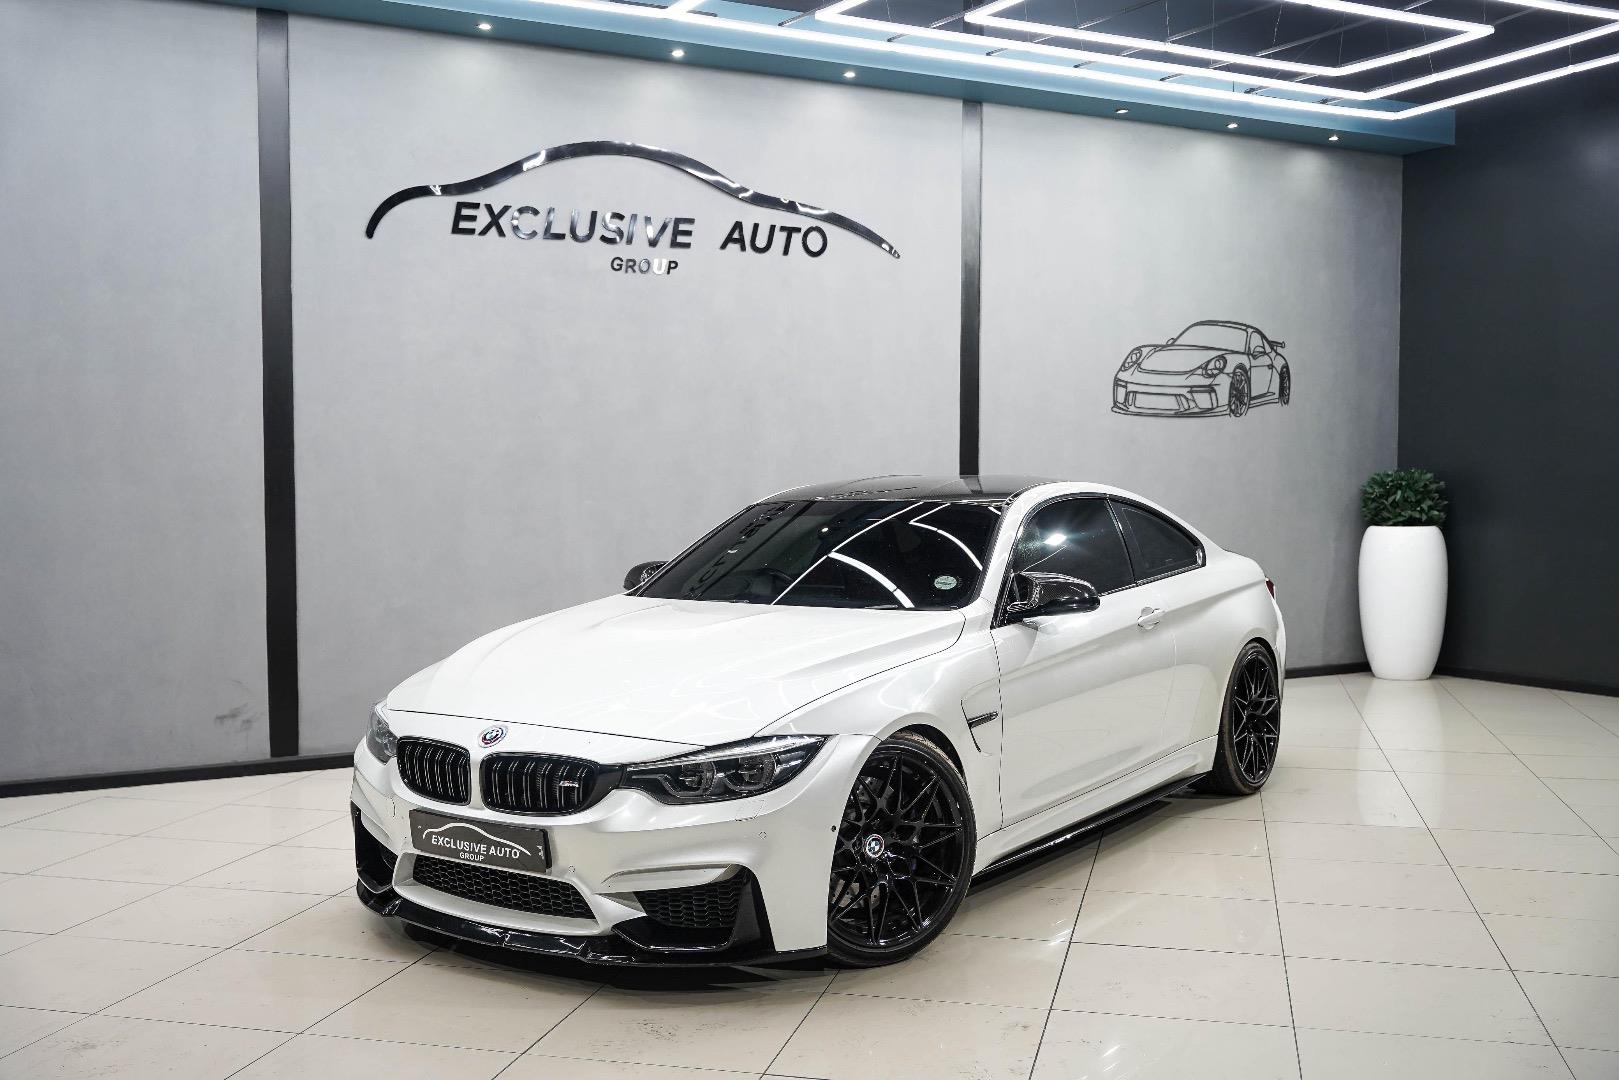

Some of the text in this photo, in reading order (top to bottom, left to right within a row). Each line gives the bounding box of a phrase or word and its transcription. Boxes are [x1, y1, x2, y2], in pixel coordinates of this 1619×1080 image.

[451, 201, 829, 258] EXCLUSIVE AUTO
[610, 256, 679, 276] GROUP
[431, 834, 520, 859] EXCLUSIVE AUTO
[459, 851, 485, 862] GROUP
